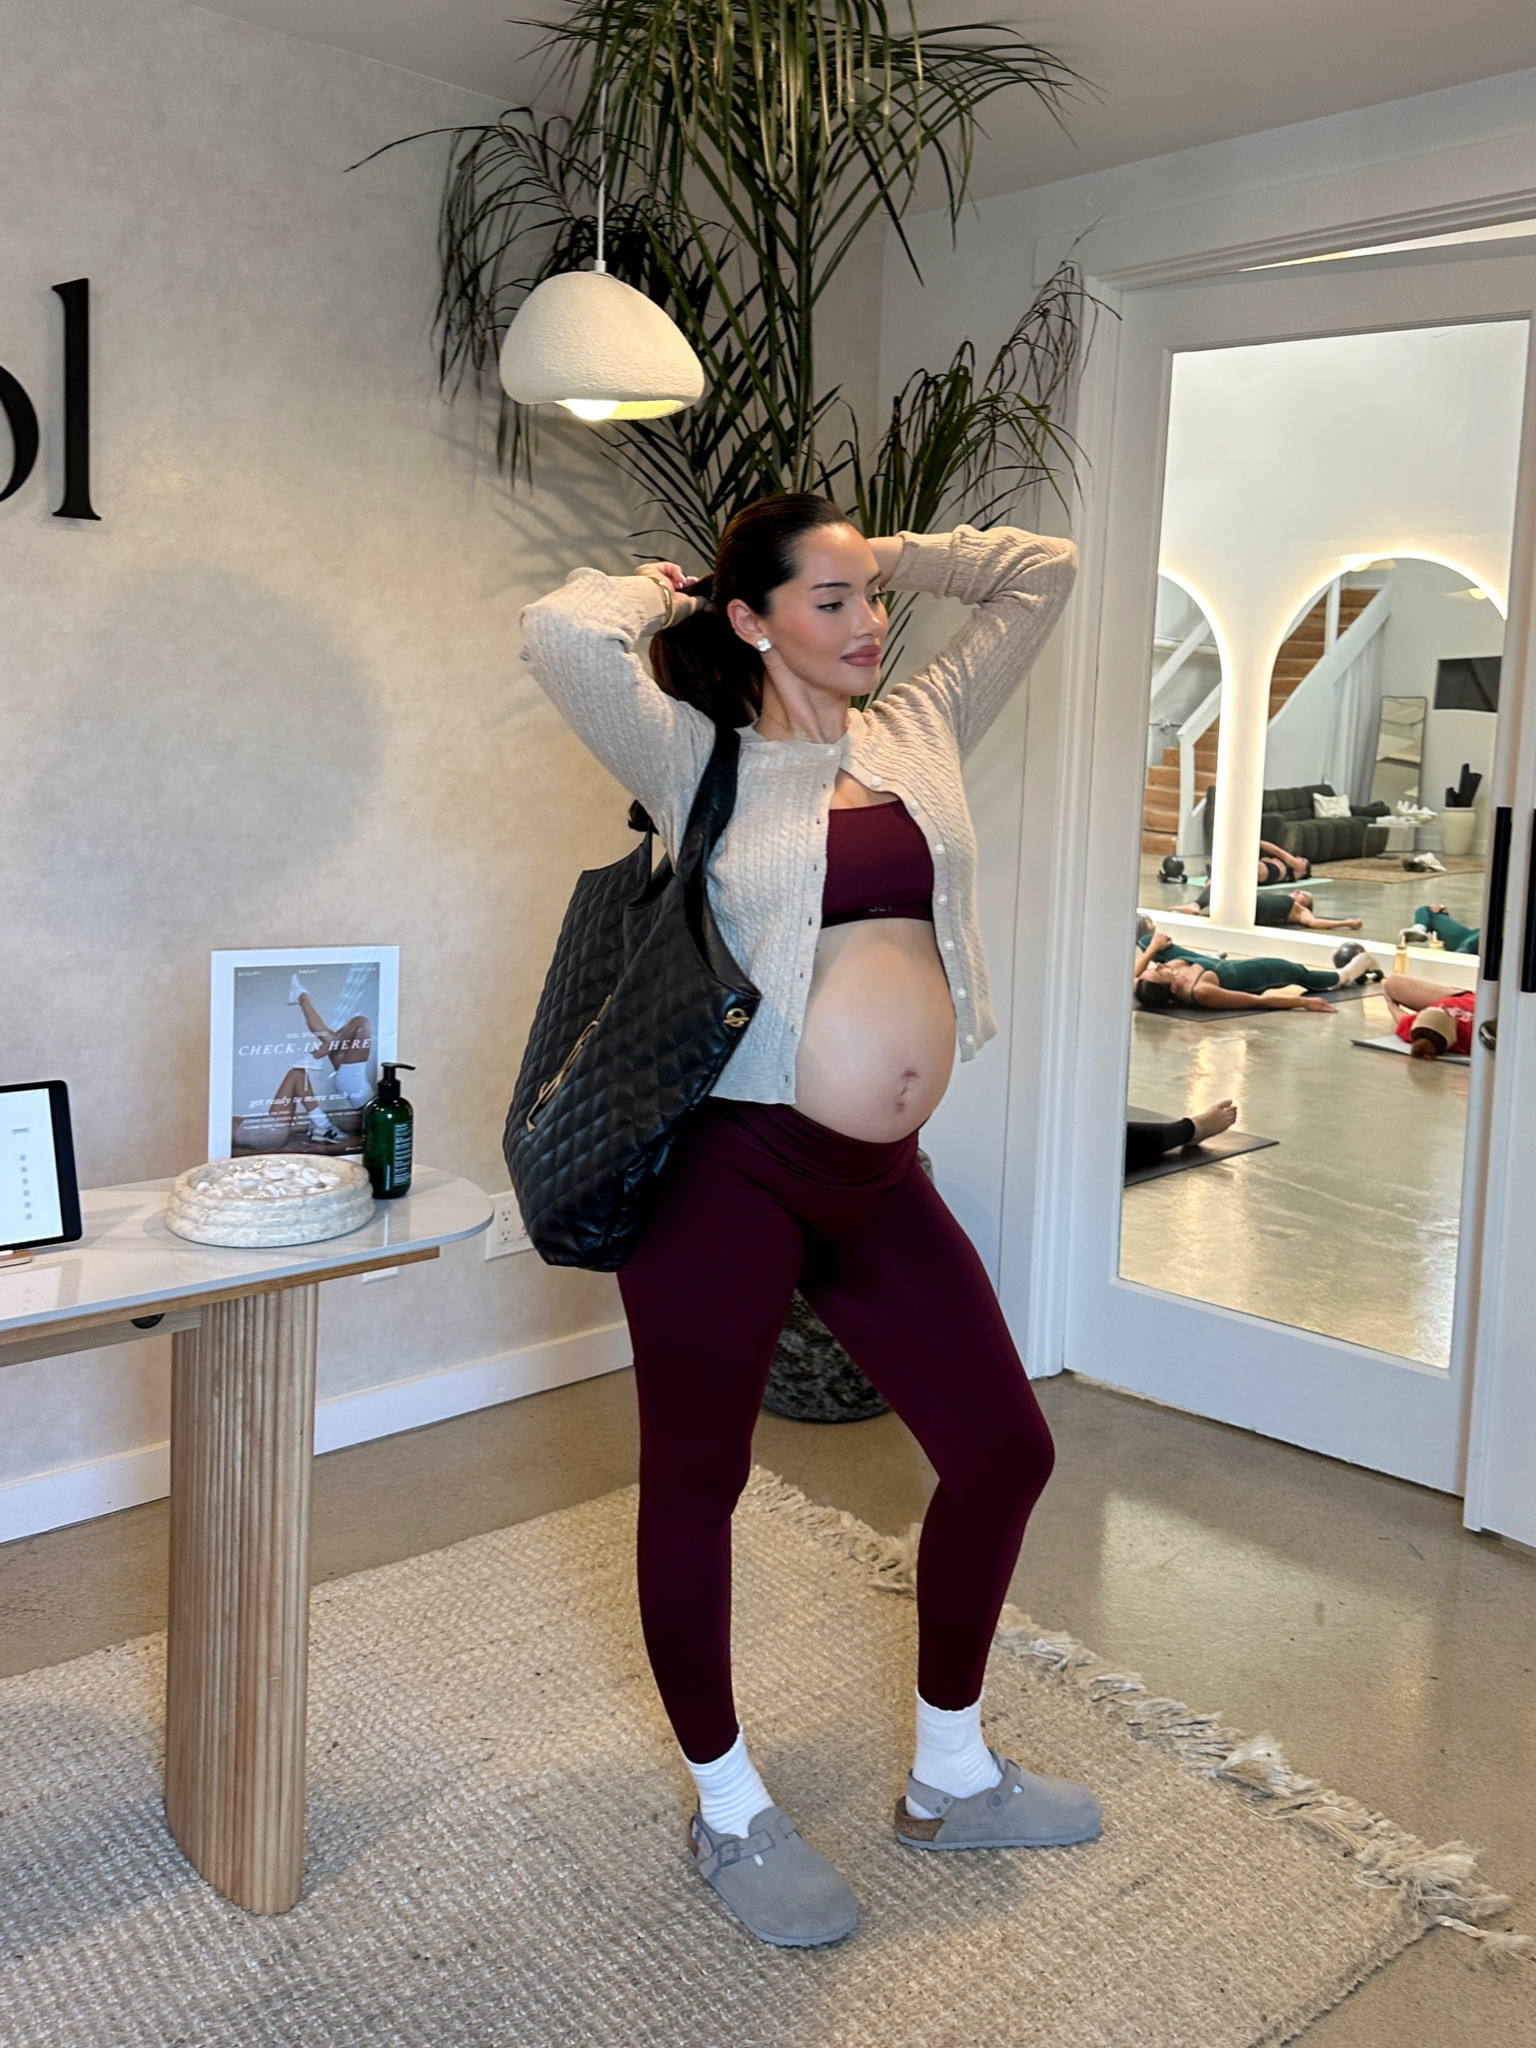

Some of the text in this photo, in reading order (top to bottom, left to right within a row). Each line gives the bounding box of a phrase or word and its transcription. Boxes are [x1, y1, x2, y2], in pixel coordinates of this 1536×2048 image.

[238, 1038, 372, 1056] CHECK-IN HERE
[266, 1096, 291, 1106] ready
